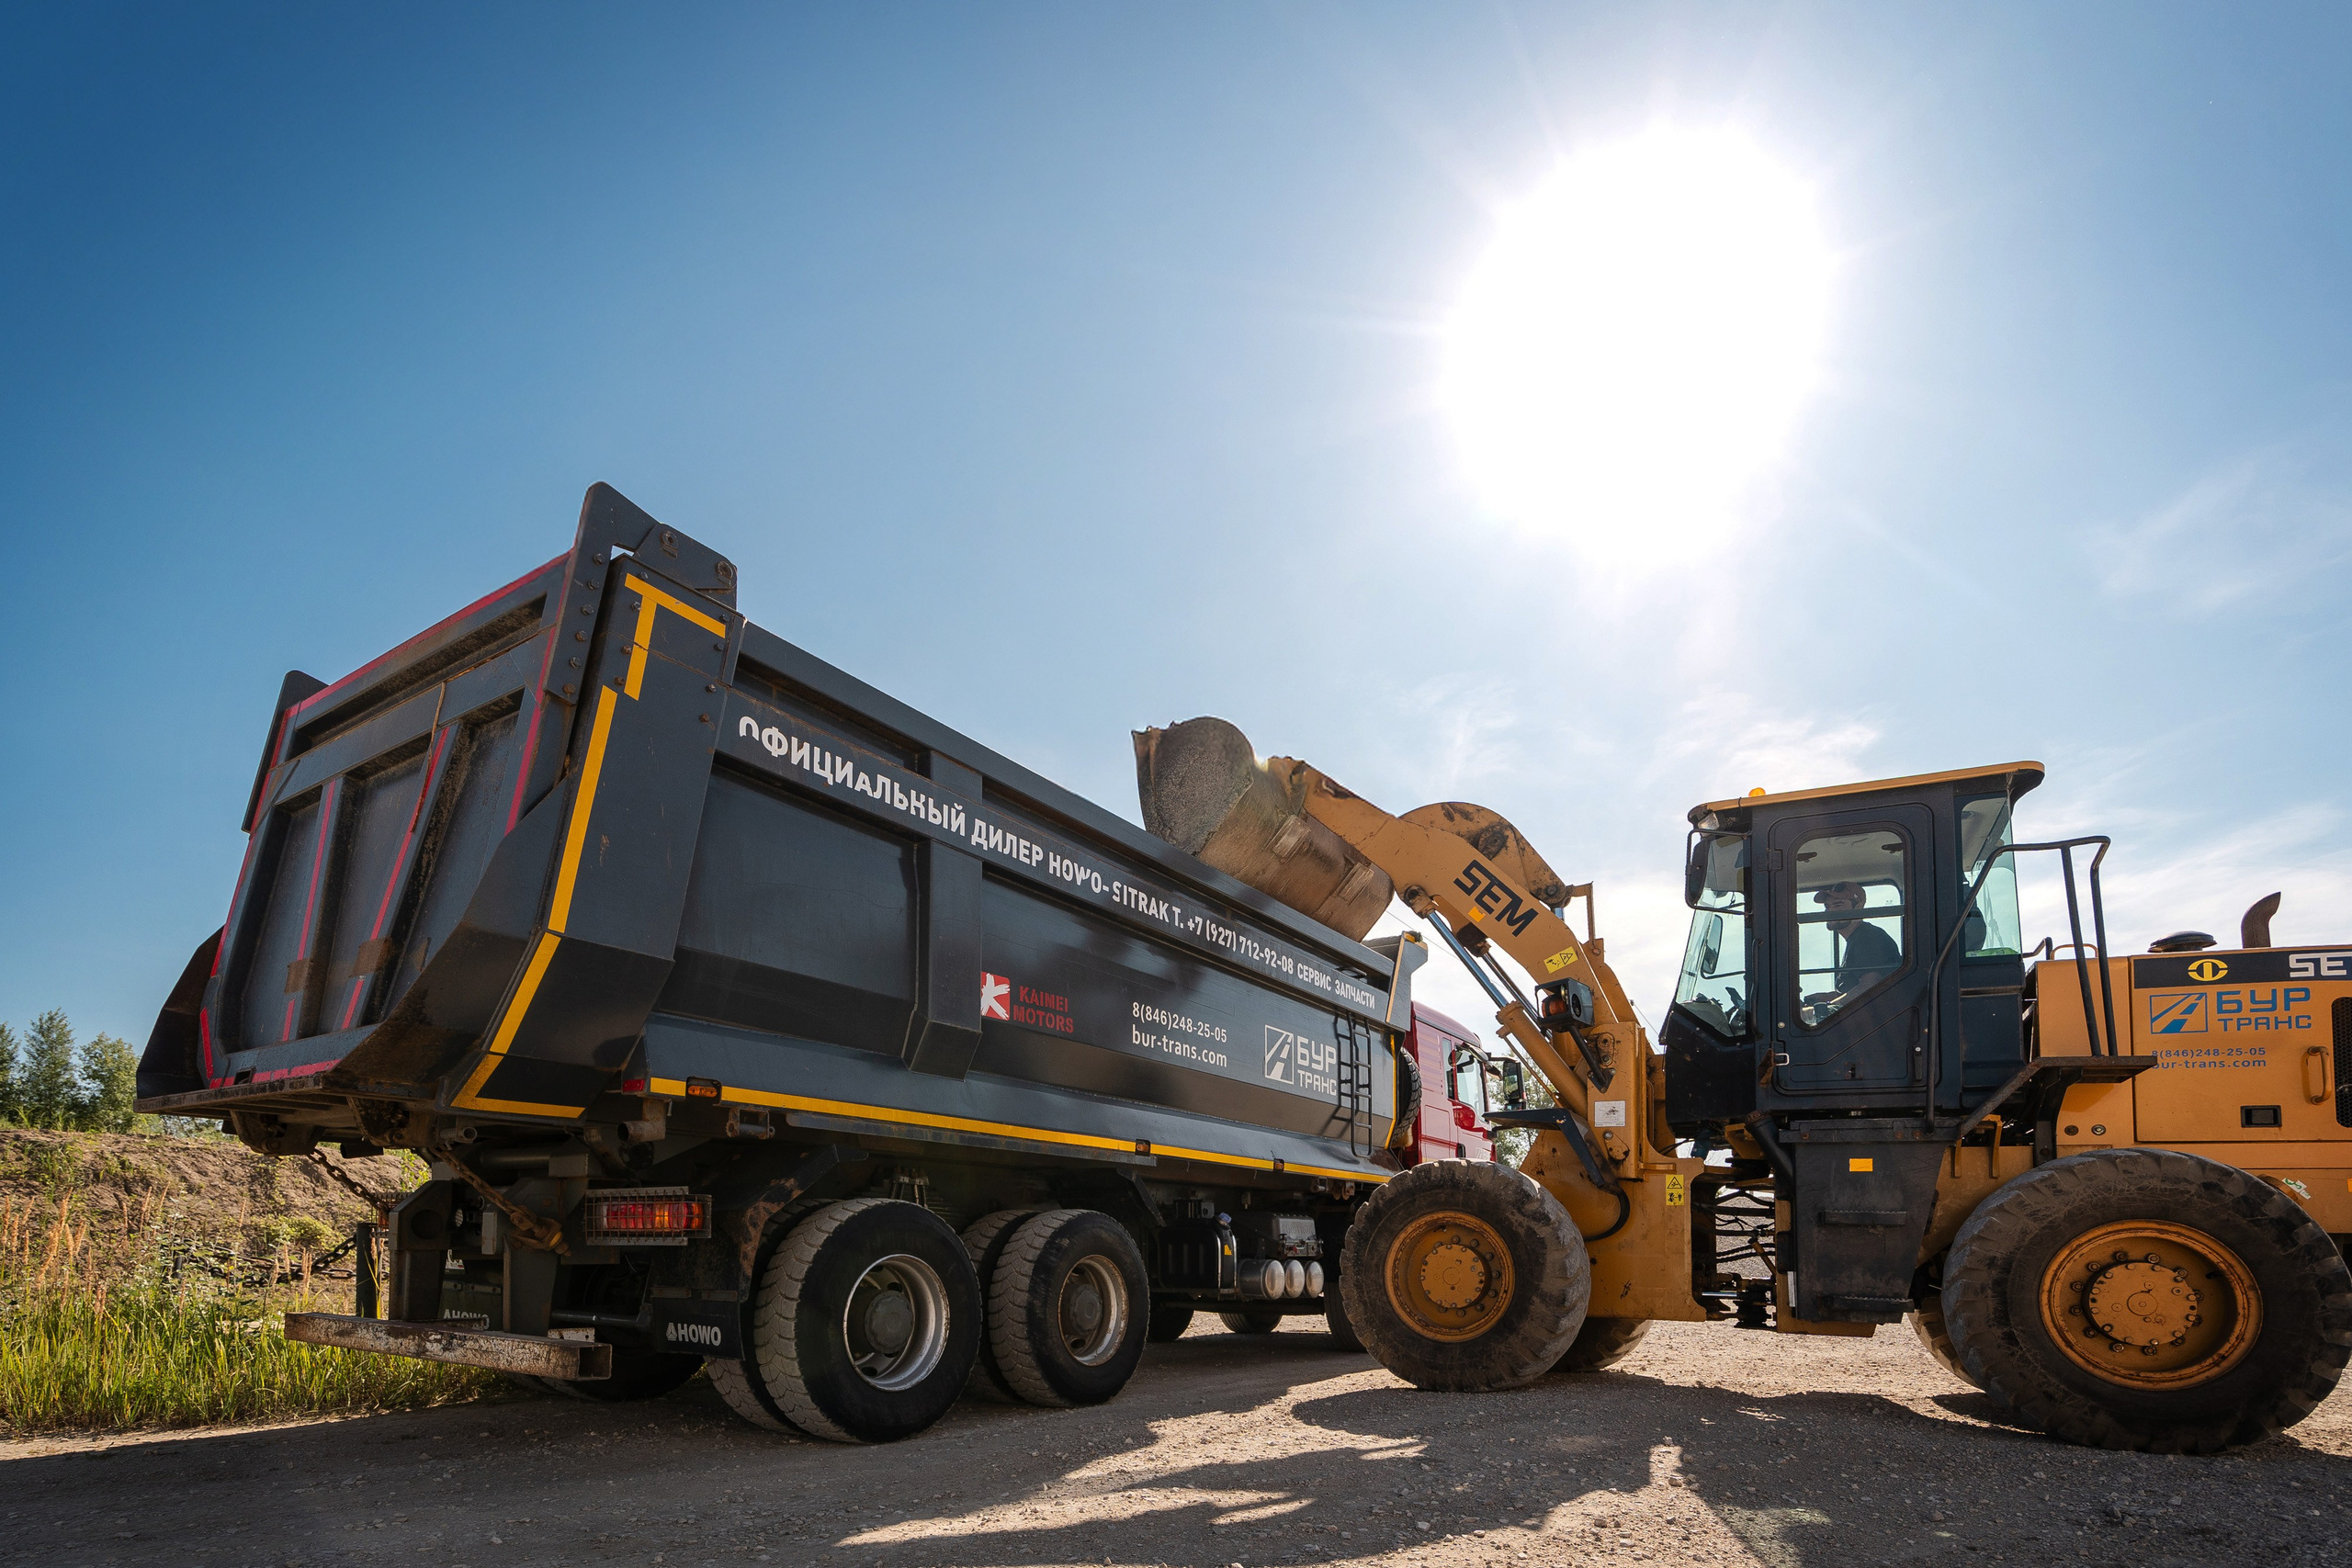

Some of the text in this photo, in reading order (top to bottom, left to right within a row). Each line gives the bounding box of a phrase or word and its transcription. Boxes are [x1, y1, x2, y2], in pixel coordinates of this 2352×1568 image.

[739, 716, 966, 837] ОФИЦИАЛЬНЫЙ
[971, 818, 1045, 867] ДИЛЕР
[1205, 919, 1237, 952] (927)
[1239, 935, 1294, 975] 712-92-08
[1297, 963, 1332, 991] СЕРВИС
[1335, 979, 1375, 1010] ЗАПЧАСТИ
[1453, 860, 1539, 937] SEM
[2289, 951, 2352, 977] SE
[1019, 985, 1069, 1012] KAIMEI
[2216, 987, 2311, 1014] БУР
[1012, 1004, 1074, 1033] MOTORS
[1132, 1001, 1227, 1043] 8(846)248-25-05
[2217, 1015, 2312, 1032] ТРАНС
[1132, 1023, 1227, 1067] bur-trans.com
[1297, 1035, 1337, 1073] БУР
[2151, 1047, 2266, 1059] 8(846)248-25-05
[1297, 1069, 1337, 1096] ТРАНС
[676, 1323, 722, 1348] HOWO
